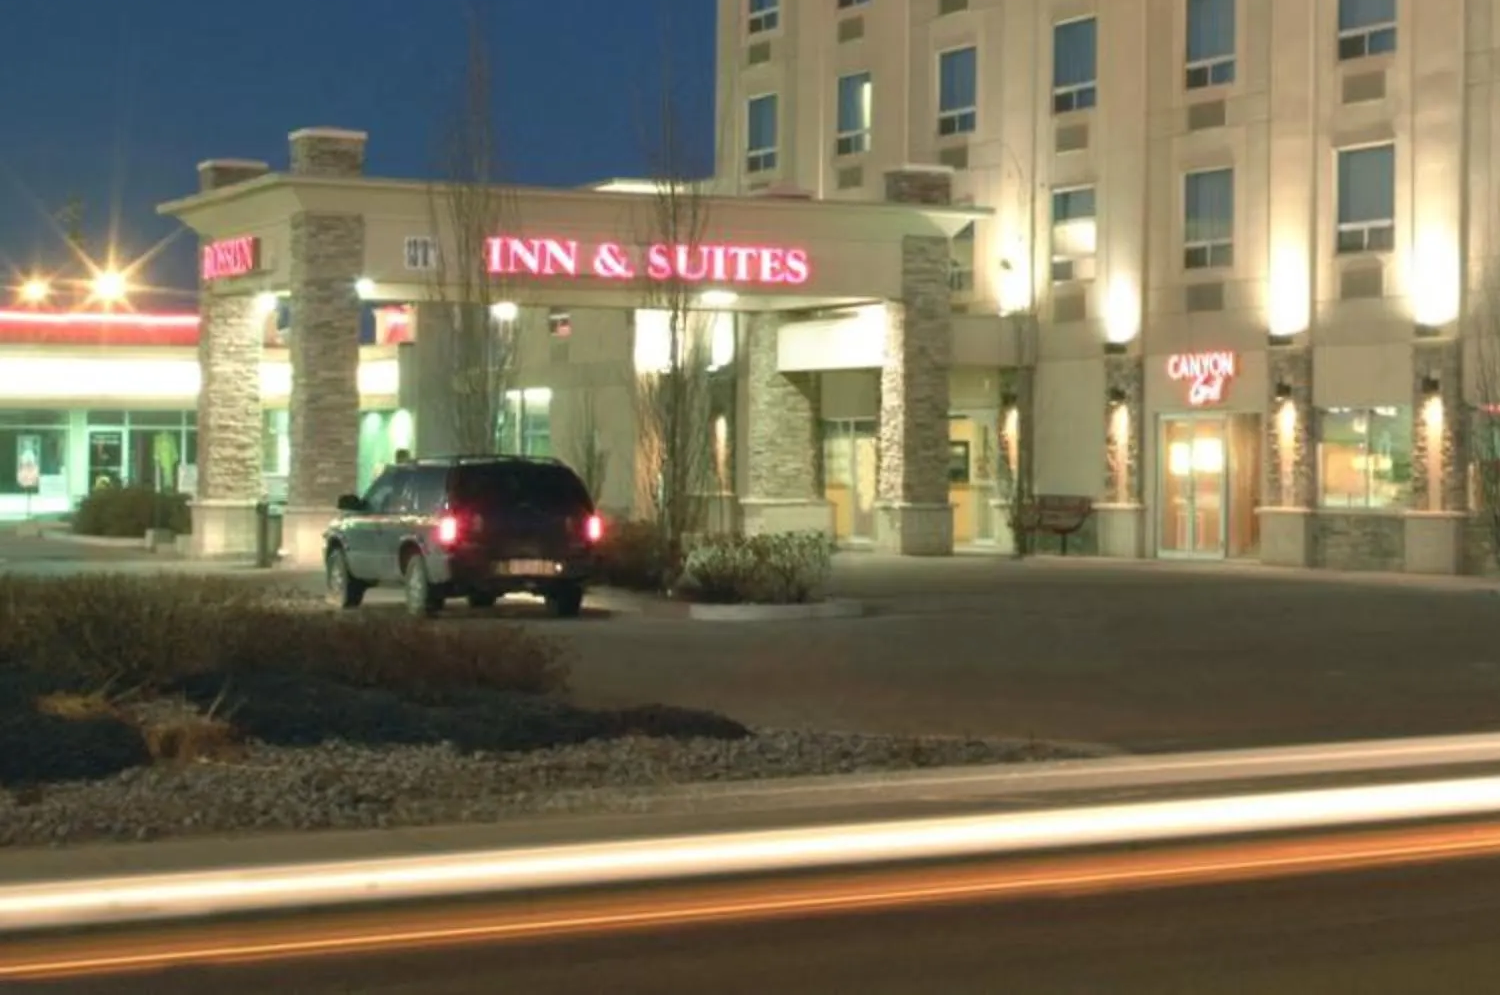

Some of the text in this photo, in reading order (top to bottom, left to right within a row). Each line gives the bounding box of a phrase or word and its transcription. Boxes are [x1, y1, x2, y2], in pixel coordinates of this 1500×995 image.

[486, 236, 810, 284] INN & SUITES
[1167, 352, 1234, 380] CANYON
